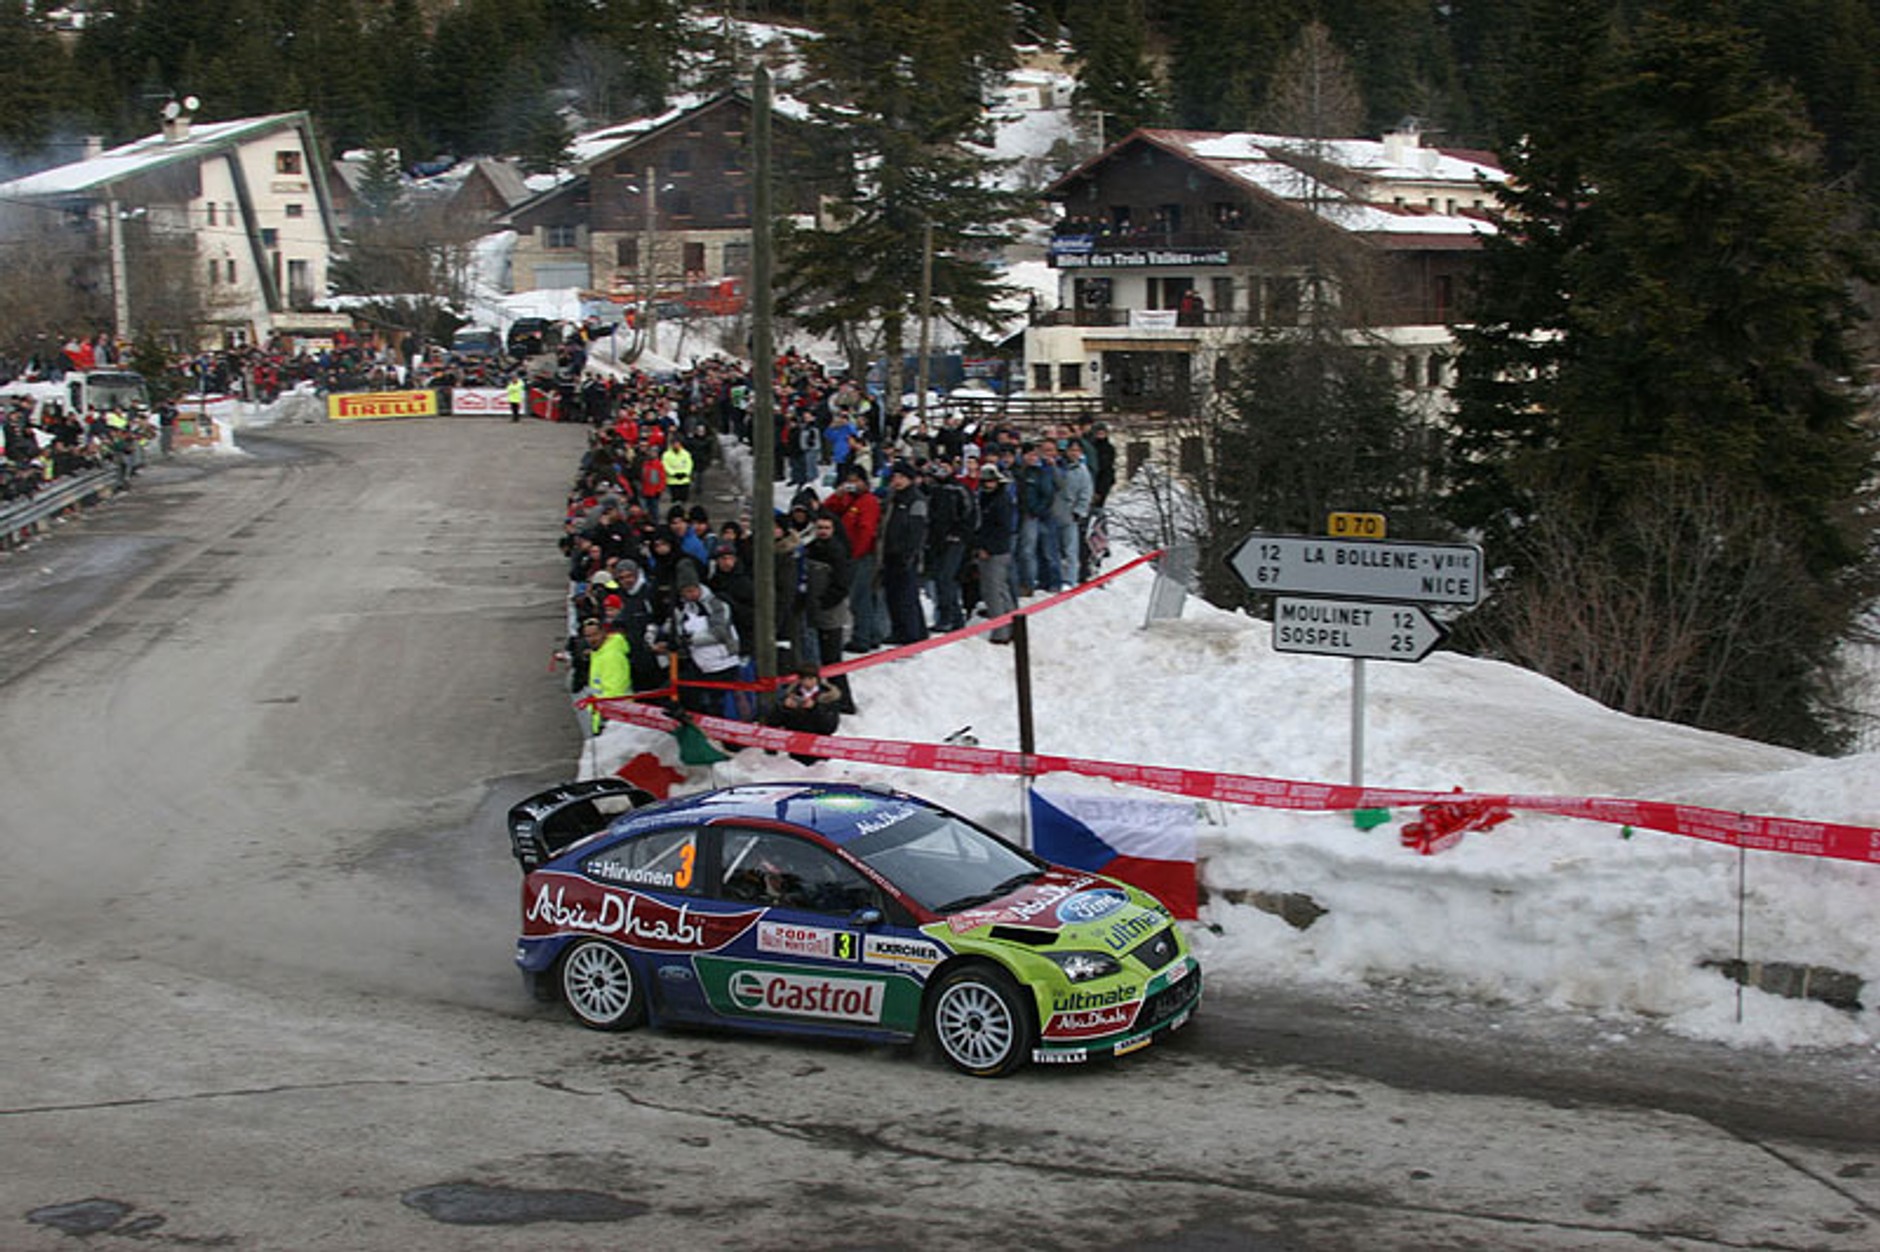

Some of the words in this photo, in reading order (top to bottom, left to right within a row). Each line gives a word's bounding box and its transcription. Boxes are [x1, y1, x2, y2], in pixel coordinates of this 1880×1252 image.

[338, 394, 428, 417] PIRELLI
[1335, 517, 1346, 533] D
[1353, 517, 1376, 534] 70
[1260, 544, 1280, 561] 12
[1303, 547, 1325, 564] LA
[1257, 566, 1280, 583] 67
[1421, 577, 1470, 596] NICE
[1281, 604, 1373, 627] MOULINET
[1393, 613, 1415, 629] 12
[1280, 627, 1353, 647] SOSPEL
[1391, 635, 1415, 651] 25
[602, 861, 674, 887] Hirvonen
[675, 844, 697, 889] 3
[527, 883, 600, 926] Abu
[598, 892, 705, 946] Dhabi
[839, 931, 851, 959] 3
[766, 977, 874, 1016] Castrol
[1053, 985, 1137, 1011] ultimate
